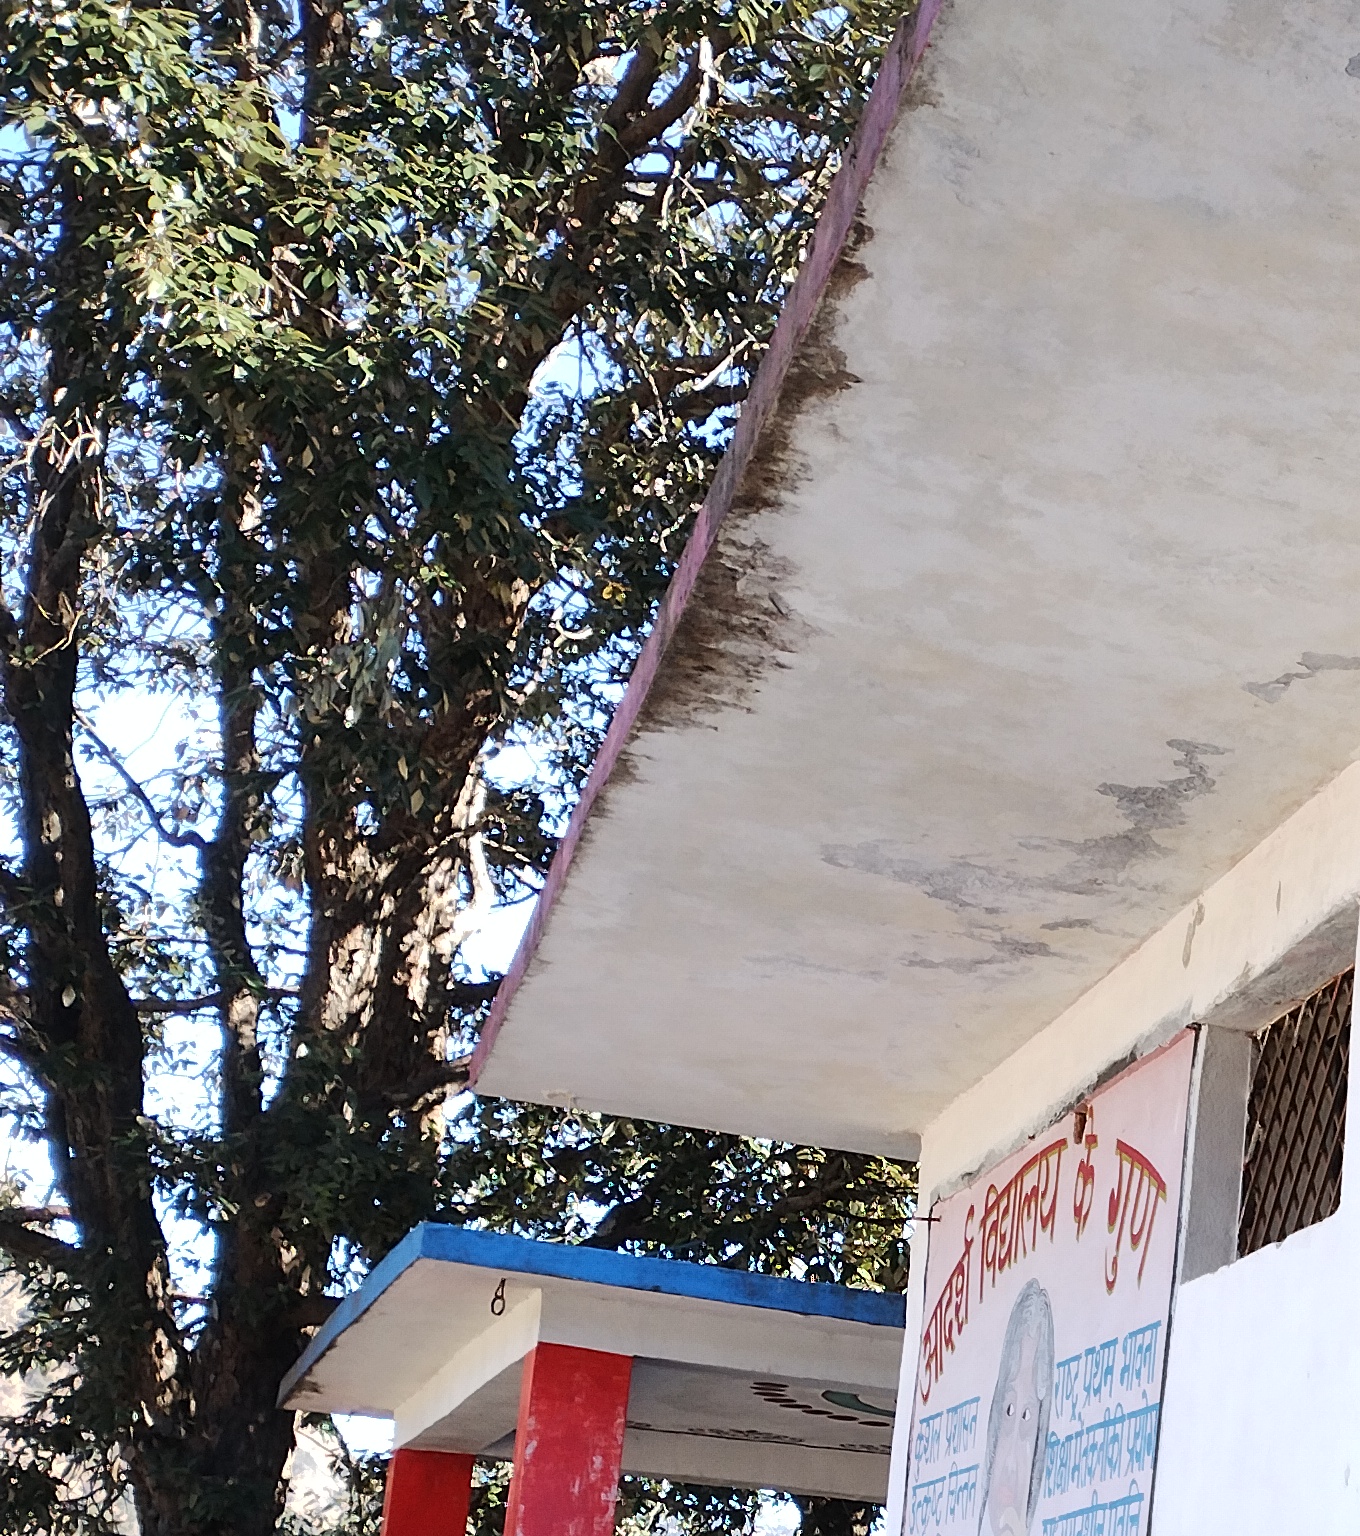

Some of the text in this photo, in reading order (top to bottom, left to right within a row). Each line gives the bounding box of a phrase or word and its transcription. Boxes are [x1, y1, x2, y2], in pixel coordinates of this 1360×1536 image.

[919, 1105, 1167, 1405] आदर्श विद्यालय के गुण
[1082, 1337, 1118, 1408] प्रथम
[1120, 1320, 1162, 1391] भावना
[915, 1396, 981, 1483] कुशल प्रशासन
